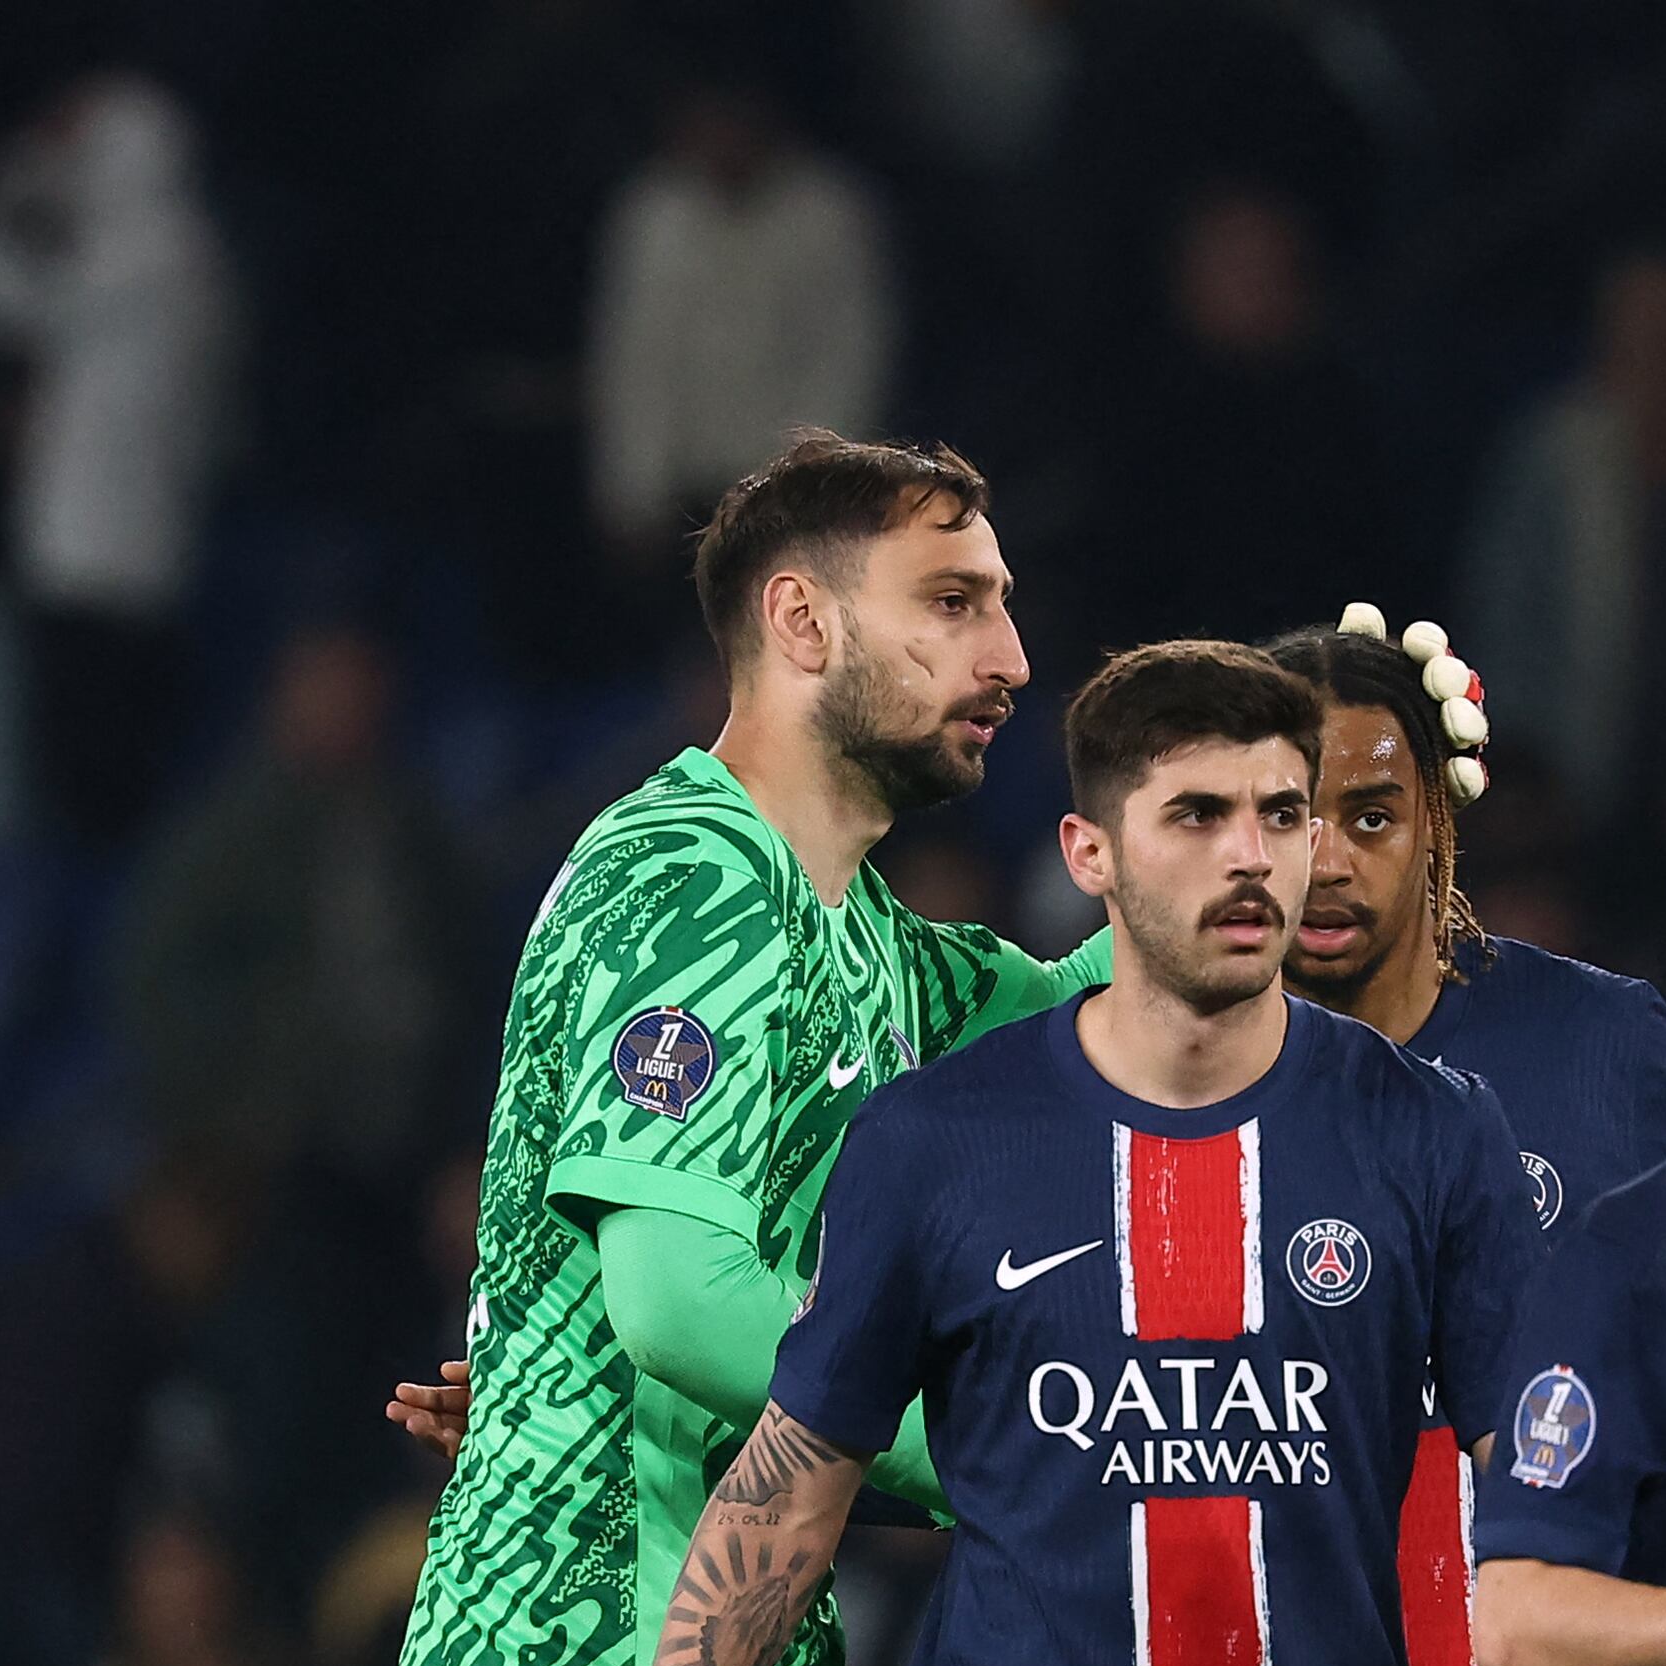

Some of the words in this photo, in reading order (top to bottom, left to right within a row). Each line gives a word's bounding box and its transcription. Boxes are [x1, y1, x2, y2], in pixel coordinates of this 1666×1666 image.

[1300, 1223, 1358, 1246] PARIS
[1029, 1358, 1329, 1451] QATAR
[1101, 1439, 1331, 1485] AIRWAYS
